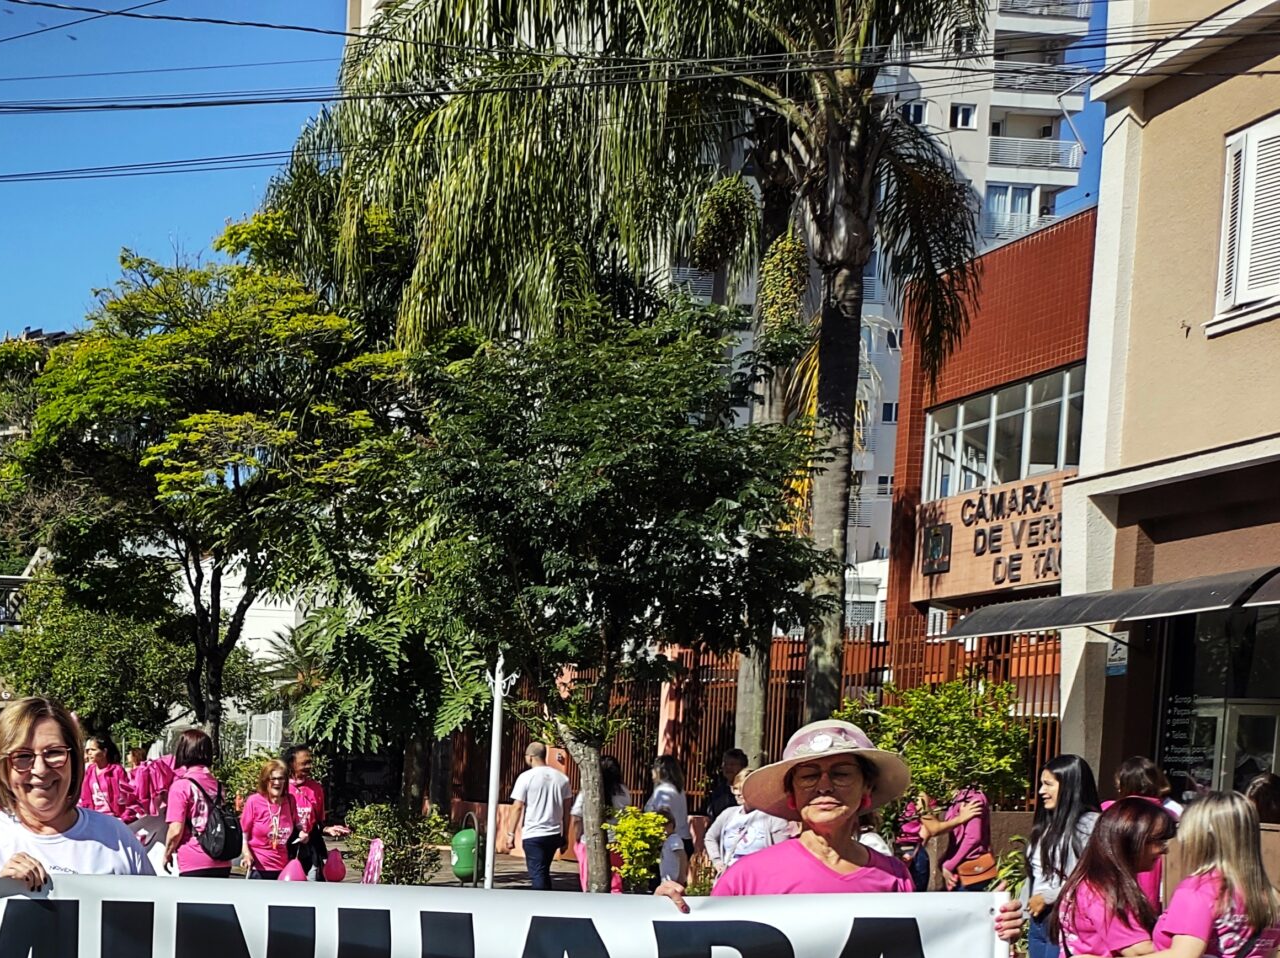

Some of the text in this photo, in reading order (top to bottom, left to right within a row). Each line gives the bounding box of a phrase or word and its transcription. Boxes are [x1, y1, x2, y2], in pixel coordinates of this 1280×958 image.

[961, 481, 1054, 527] CÂMARA
[974, 524, 1003, 557] DE
[993, 553, 1022, 585] DE
